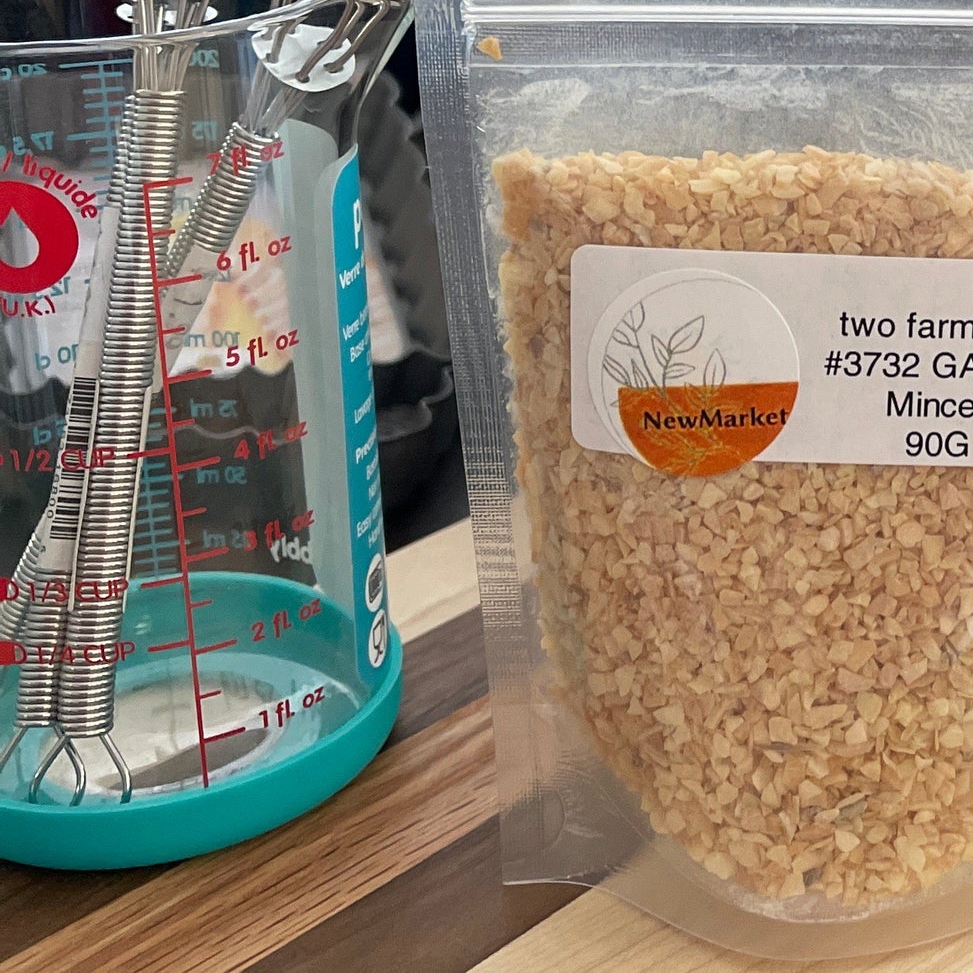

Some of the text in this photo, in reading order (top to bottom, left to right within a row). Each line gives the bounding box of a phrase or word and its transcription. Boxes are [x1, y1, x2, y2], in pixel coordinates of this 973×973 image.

[206, 152, 221, 176] 7
[260, 141, 285, 161] oz
[23, 153, 98, 219] liquide
[216, 250, 232, 271] 6
[267, 236, 292, 256] oz
[840, 311, 896, 338] two
[226, 345, 240, 367] 5
[275, 329, 299, 350] oz
[824, 350, 920, 378] #3732
[643, 406, 789, 430] NewMarket
[234, 439, 250, 459] 4
[284, 421, 308, 442] oz
[905, 431, 969, 457] 90G
[10, 446, 115, 472] 1/2 CUP
[27, 578, 129, 603] 1/3 CUP
[251, 621, 266, 642] 2
[300, 598, 322, 620] oz
[34, 641, 135, 665] 1/4 CUP
[259, 709, 269, 728] 1
[302, 686, 325, 708] oz
